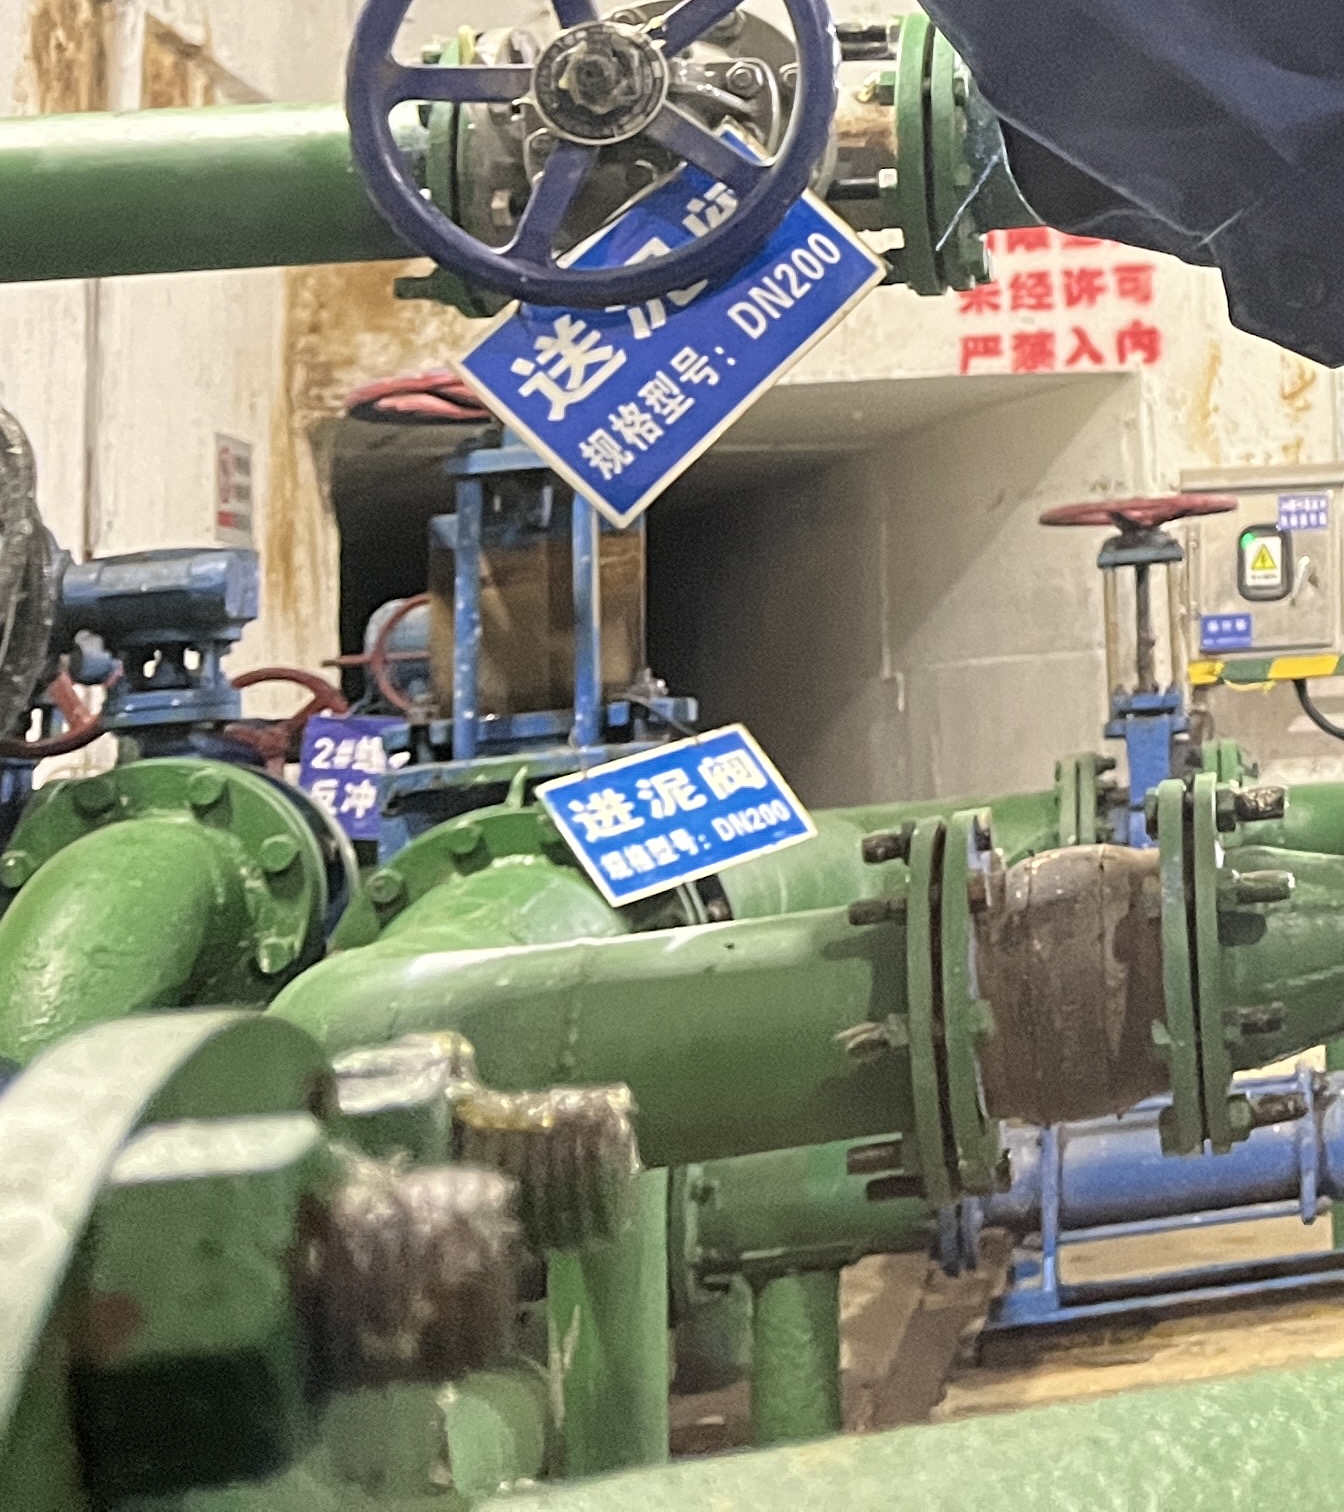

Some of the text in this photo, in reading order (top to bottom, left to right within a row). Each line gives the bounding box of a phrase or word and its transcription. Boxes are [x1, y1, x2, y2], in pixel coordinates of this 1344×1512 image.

[959, 261, 1156, 315] 未经许可
[958, 319, 1164, 376] 严禁入内
